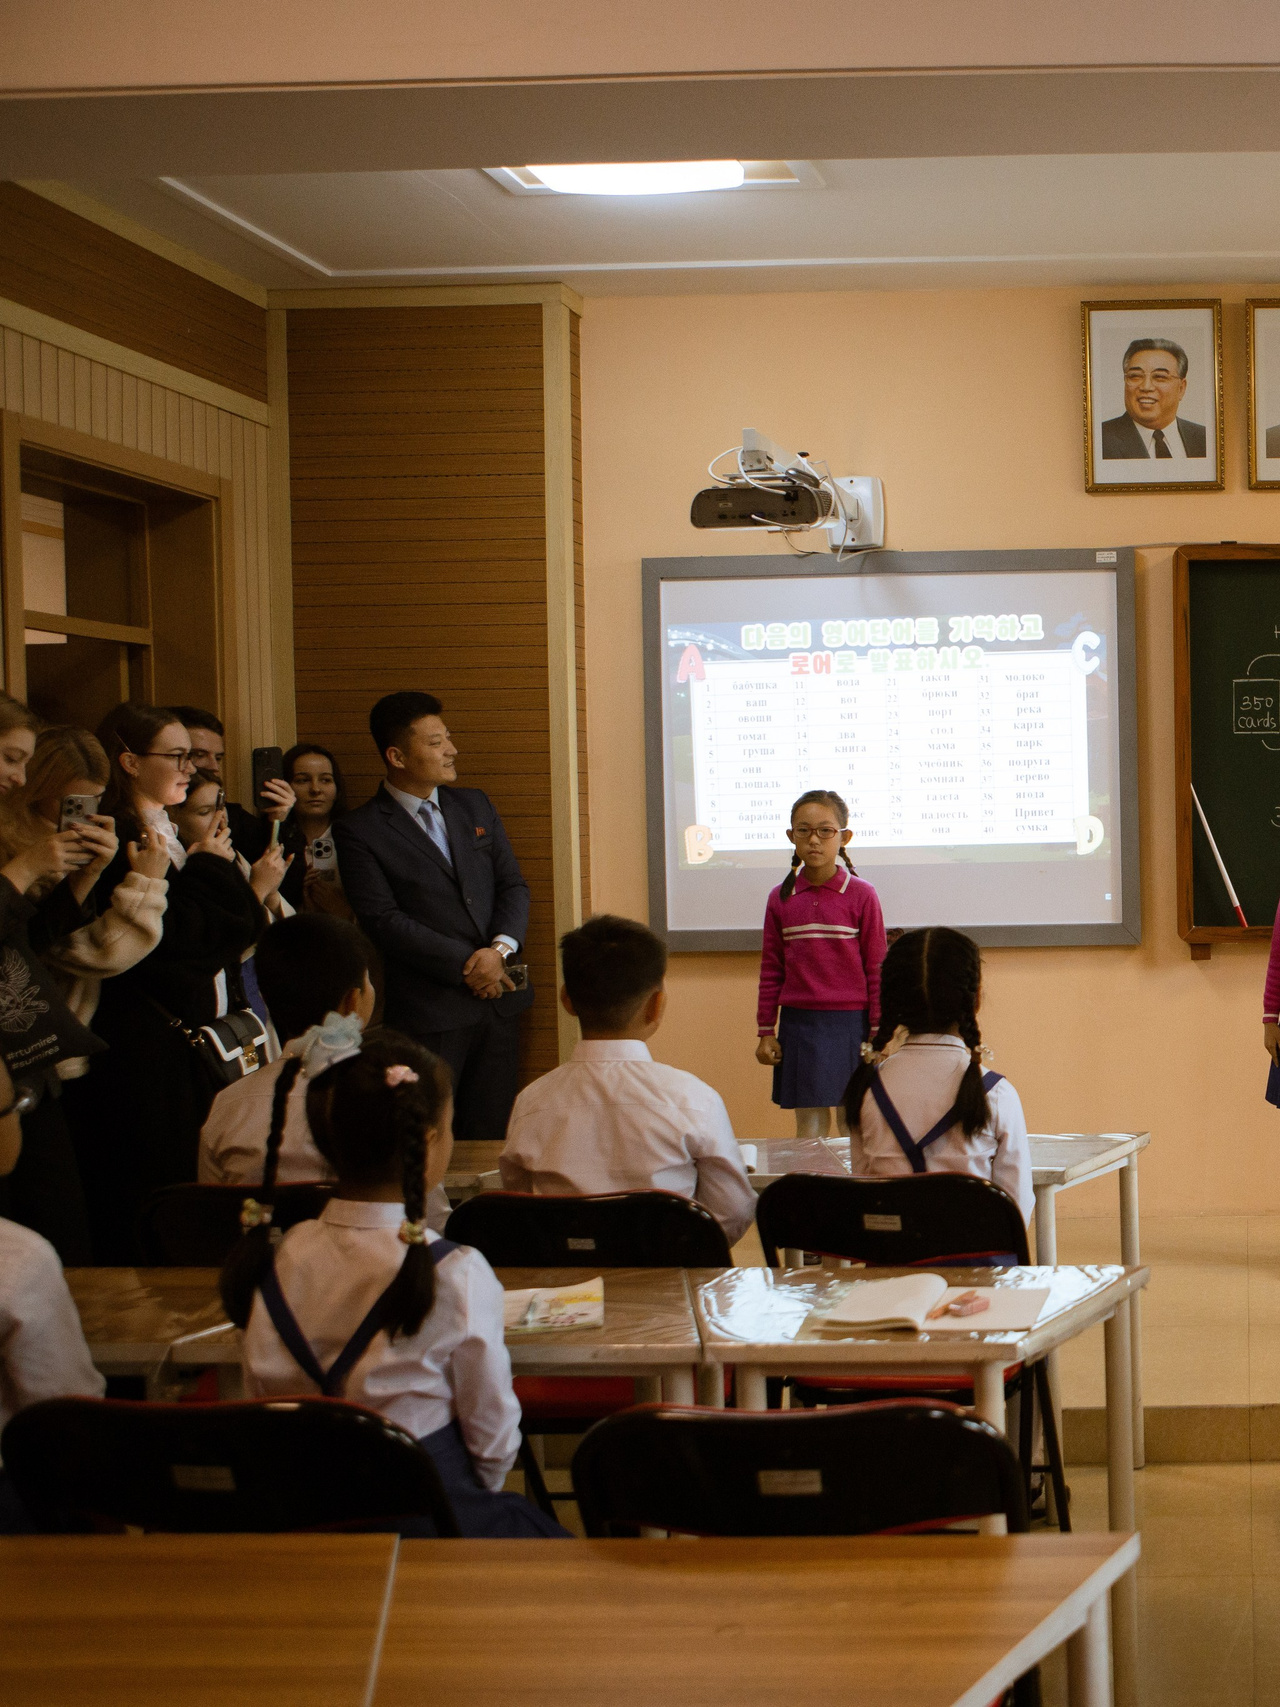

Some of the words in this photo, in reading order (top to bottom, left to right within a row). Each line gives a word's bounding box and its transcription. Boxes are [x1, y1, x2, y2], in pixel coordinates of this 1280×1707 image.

[742, 623, 810, 649] 다음의
[823, 618, 937, 646] 영어단어를
[950, 615, 1042, 641] 기억하고
[791, 652, 855, 675] 로어로
[870, 647, 989, 672] 발표하시오.
[1072, 631, 1101, 675] C
[677, 644, 706, 683] A
[732, 681, 778, 693] бабушка
[795, 681, 804, 689] 11
[836, 679, 860, 687] вода
[886, 678, 896, 686] 21
[921, 674, 950, 682] такси
[979, 675, 989, 683] 31
[1004, 673, 1045, 681] молоко
[746, 699, 767, 707] ваш
[796, 698, 806, 706] 12
[840, 696, 857, 704] вот
[888, 695, 898, 703] 22
[922, 688, 958, 700] брюки
[1016, 690, 1039, 700] брат
[1240, 696, 1274, 710] 350
[796, 714, 806, 722] 13
[840, 712, 858, 720] кит
[888, 711, 898, 720] 23
[928, 708, 952, 718] порт
[979, 708, 991, 716] 33
[1017, 706, 1042, 716] река
[1238, 711, 1277, 729] cards
[737, 733, 766, 741] томат
[888, 729, 899, 737] 24
[930, 727, 953, 735] стол
[1013, 722, 1044, 731] карта
[743, 748, 775, 758] груша
[798, 748, 808, 756] 15
[835, 745, 866, 753] книга
[889, 745, 900, 753] 25
[928, 742, 956, 750] мама
[981, 742, 991, 751] 35
[1016, 739, 1043, 749] парк
[743, 766, 761, 774] они
[890, 762, 900, 770] 26
[919, 758, 963, 770] учебник
[982, 759, 992, 767] 36
[1009, 758, 1050, 769] подруга
[799, 781, 809, 789] 17
[920, 775, 965, 784] комната
[982, 776, 992, 784] 37
[1015, 773, 1050, 783] дерево
[751, 799, 773, 807] поэт
[927, 793, 959, 801] газета
[1016, 791, 1044, 799] ягода
[738, 812, 781, 823] барабан
[891, 812, 902, 820] 29
[983, 809, 993, 817] 39
[1015, 808, 1054, 818] Привет
[744, 831, 775, 839] пенал
[891, 828, 902, 836] 30
[932, 826, 950, 834] она
[1016, 824, 1048, 834] сумка
[1073, 815, 1104, 855] D
[684, 825, 714, 865] B
[6, 1033, 58, 1060] #rtumirea
